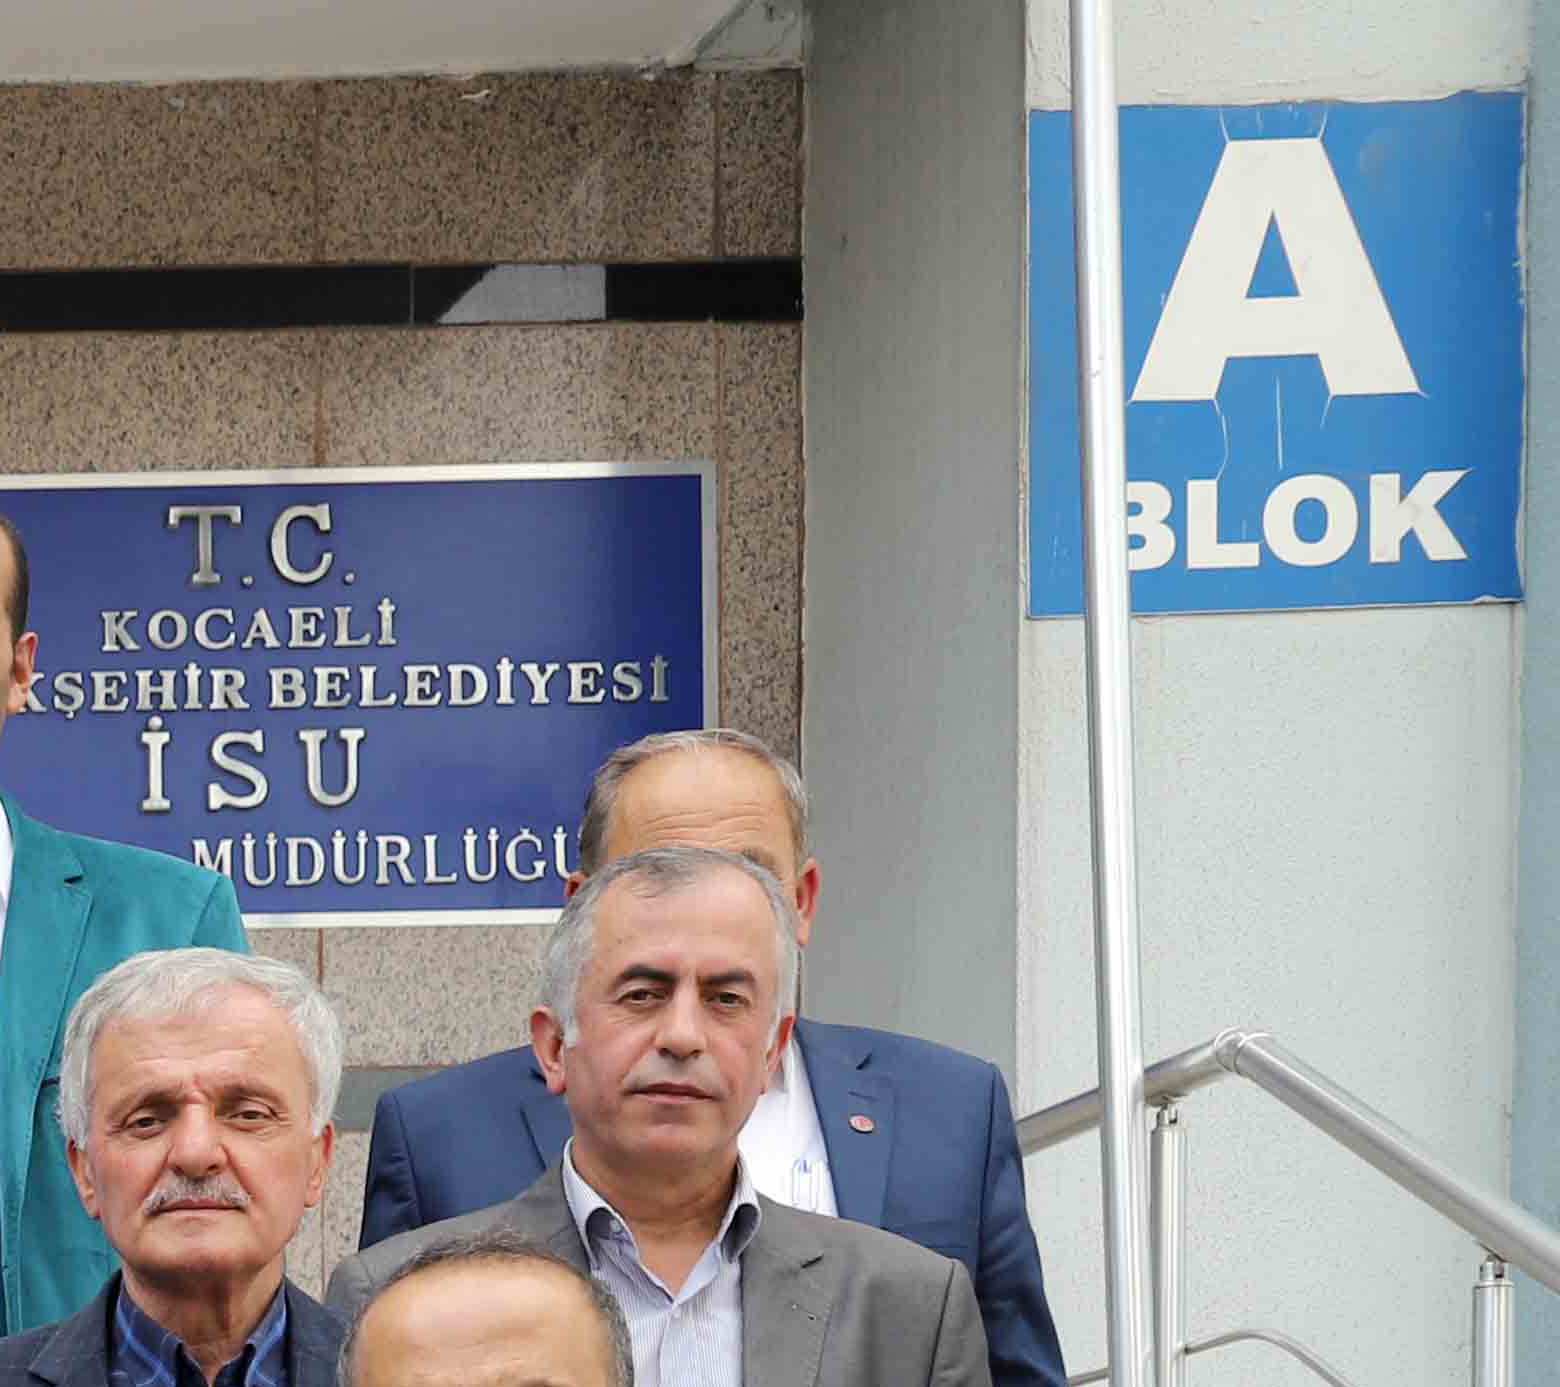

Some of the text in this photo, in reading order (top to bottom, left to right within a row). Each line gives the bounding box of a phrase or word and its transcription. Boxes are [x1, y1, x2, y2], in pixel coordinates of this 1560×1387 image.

[1129, 137, 1422, 402] A
[167, 503, 356, 586] T.C.
[1125, 468, 1472, 571] BLOK
[100, 598, 398, 652] KOCAELİ
[19, 654, 670, 718] KŞEHİR BELEDİYESİ
